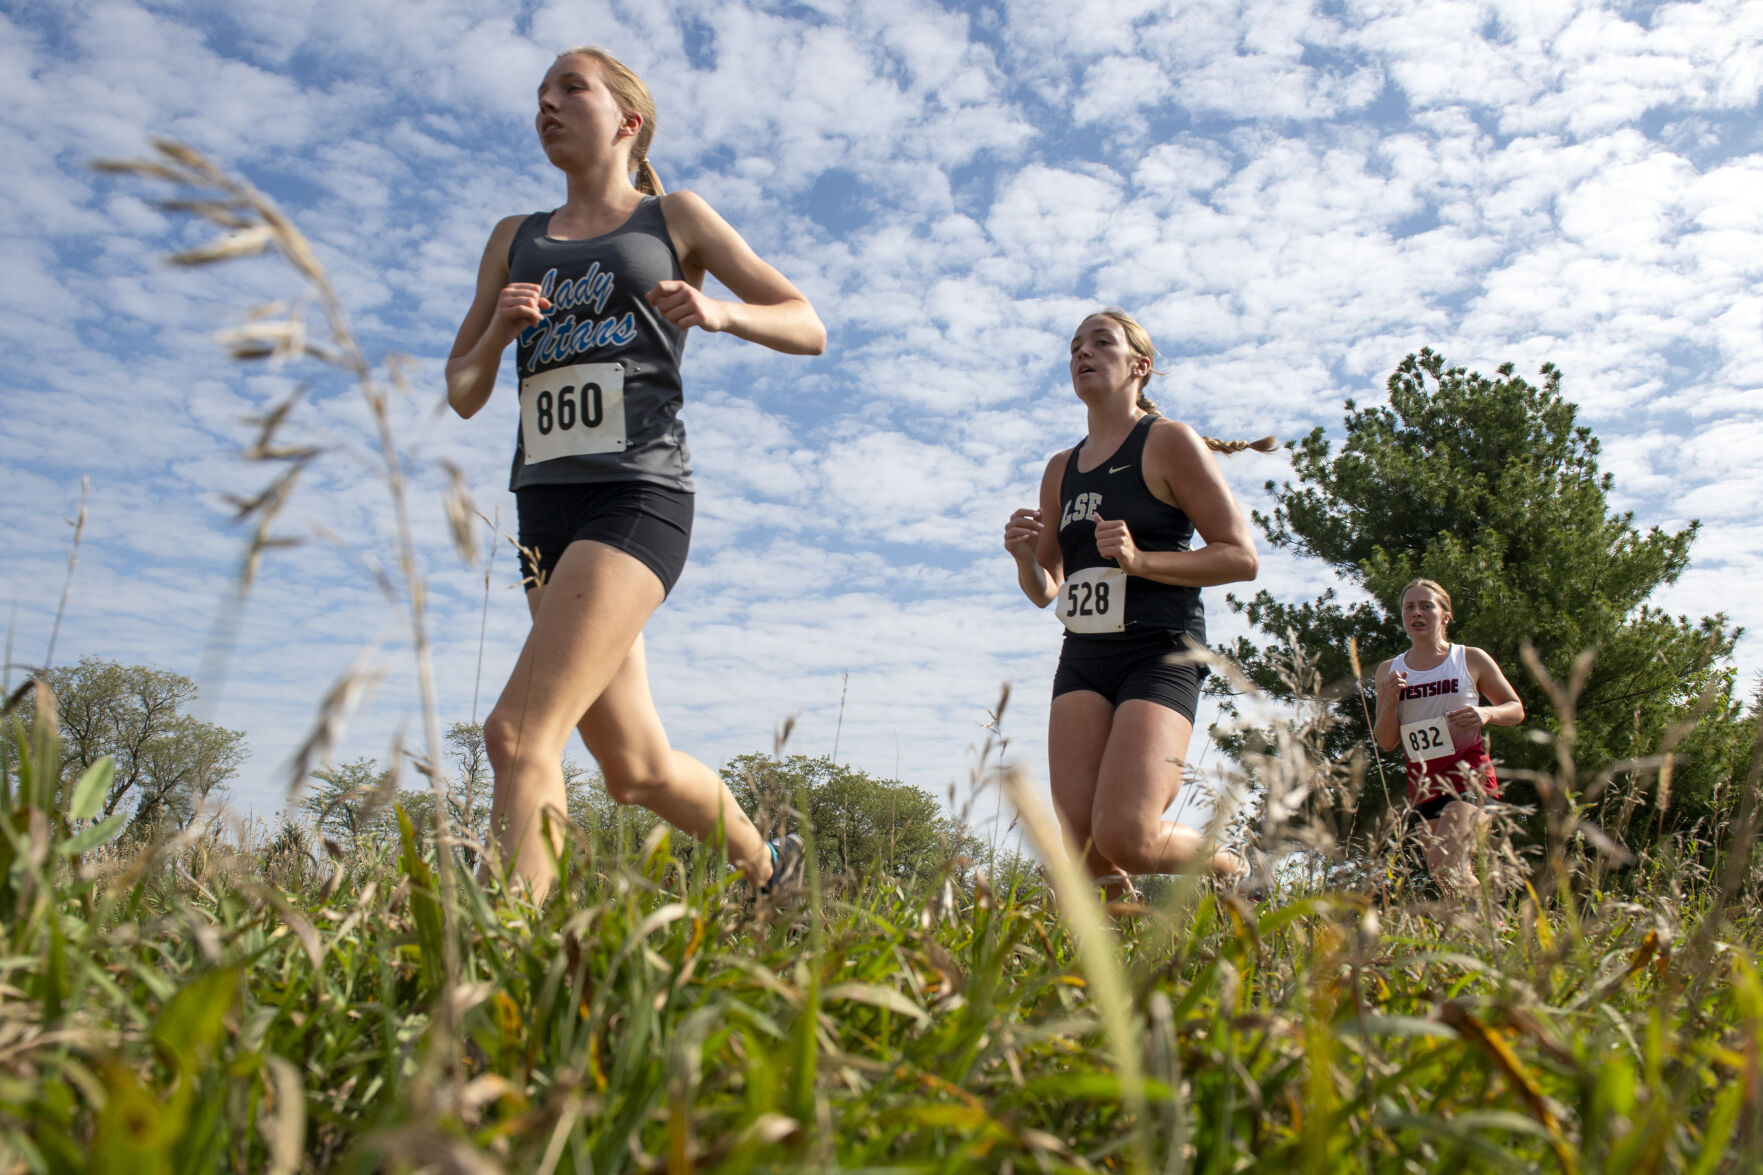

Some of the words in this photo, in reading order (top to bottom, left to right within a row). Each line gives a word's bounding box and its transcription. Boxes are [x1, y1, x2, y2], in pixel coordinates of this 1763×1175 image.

[540, 261, 614, 316] Lady
[519, 312, 638, 372] Titans
[537, 382, 604, 436] 860
[1060, 492, 1103, 532] LSE
[1067, 581, 1110, 617] 528
[1408, 726, 1444, 752] 832
